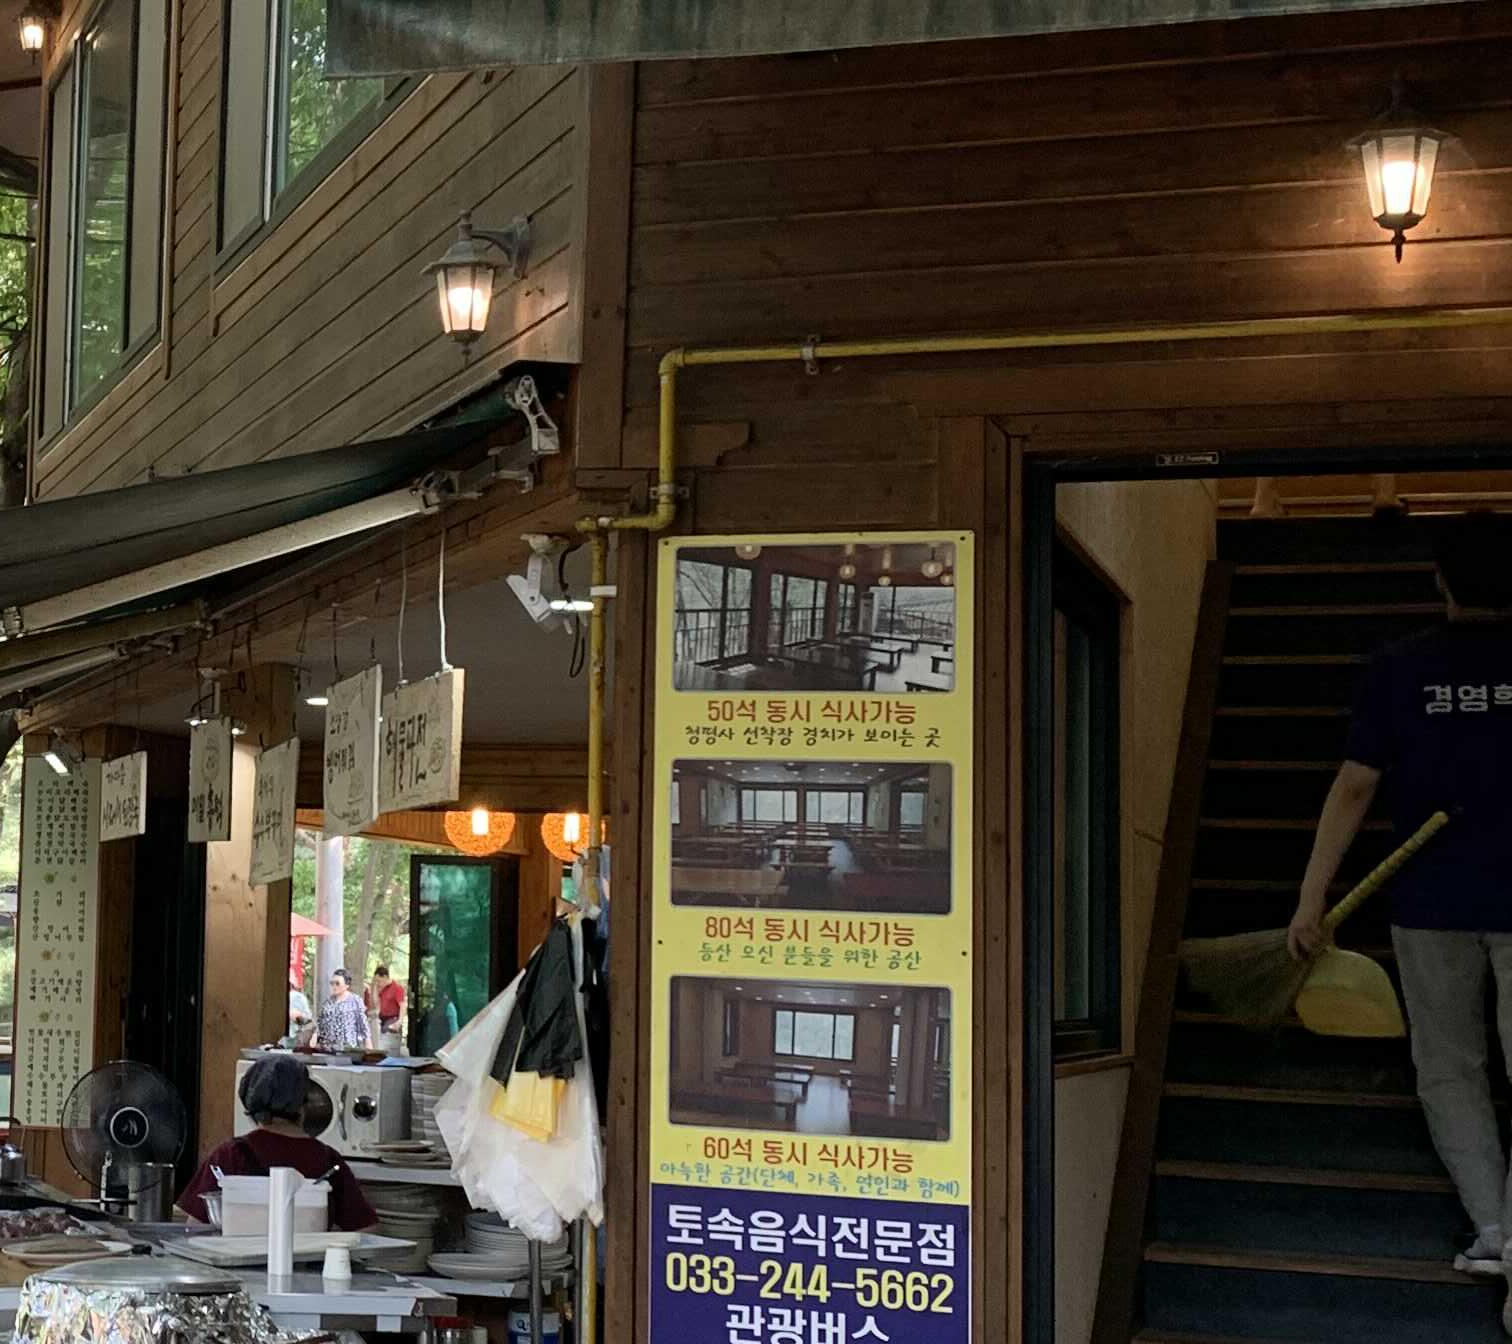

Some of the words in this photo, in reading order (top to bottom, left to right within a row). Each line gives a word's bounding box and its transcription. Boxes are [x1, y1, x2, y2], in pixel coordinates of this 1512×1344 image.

[707, 699, 757, 722] 50석
[765, 699, 811, 724] 동시
[820, 700, 917, 725] 식사가능
[685, 725, 735, 746] 청평사
[743, 726, 793, 745] 선착장
[803, 727, 854, 746] 경치가
[864, 728, 915, 748] 보이는
[924, 728, 941, 748] 곳
[704, 916, 754, 940] 80석
[764, 918, 809, 943] 동시
[818, 920, 915, 947] 식사가능
[698, 942, 732, 962] 등산
[783, 946, 834, 967] 분들을
[843, 948, 879, 969] 위한
[703, 1136, 753, 1162] 60석
[762, 1140, 808, 1166] 동시
[817, 1143, 914, 1174] 식사가능
[660, 1161, 712, 1183] 아늑한
[666, 1204, 955, 1267] 토속음식전문점
[665, 1252, 955, 1314] 033-244-5662
